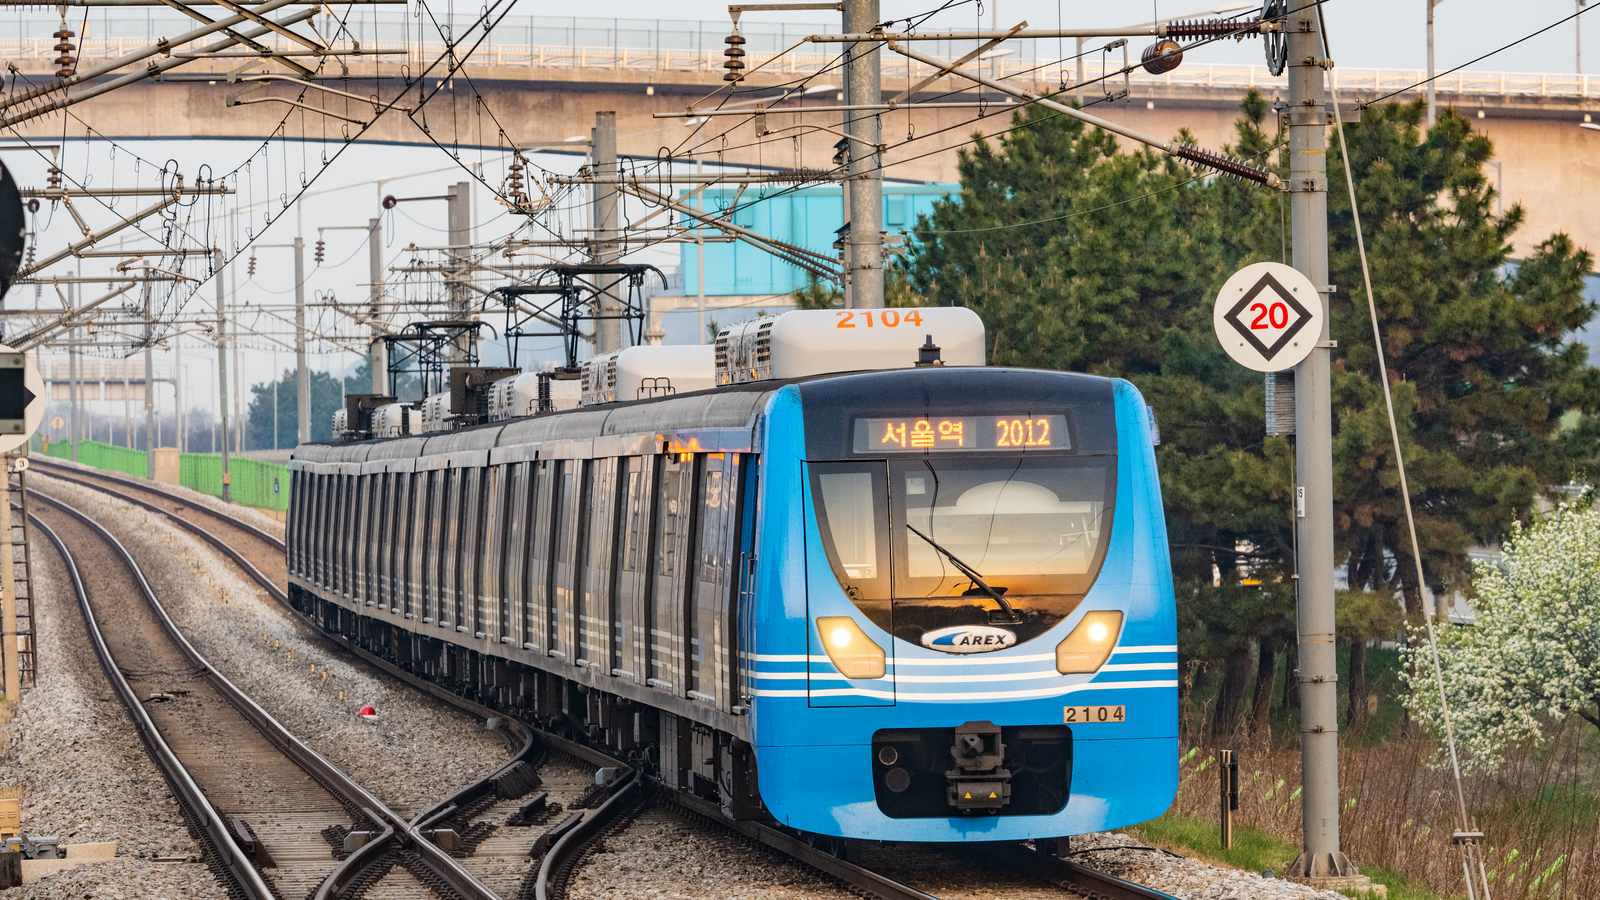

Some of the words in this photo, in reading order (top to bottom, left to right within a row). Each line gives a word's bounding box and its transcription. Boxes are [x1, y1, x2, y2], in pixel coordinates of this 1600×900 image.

[836, 310, 923, 328] 2104
[1250, 302, 1288, 330] 20
[881, 419, 964, 448] 서울역
[996, 419, 1051, 447] 2012
[959, 634, 1007, 646] AREX
[1066, 706, 1123, 722] 2104
